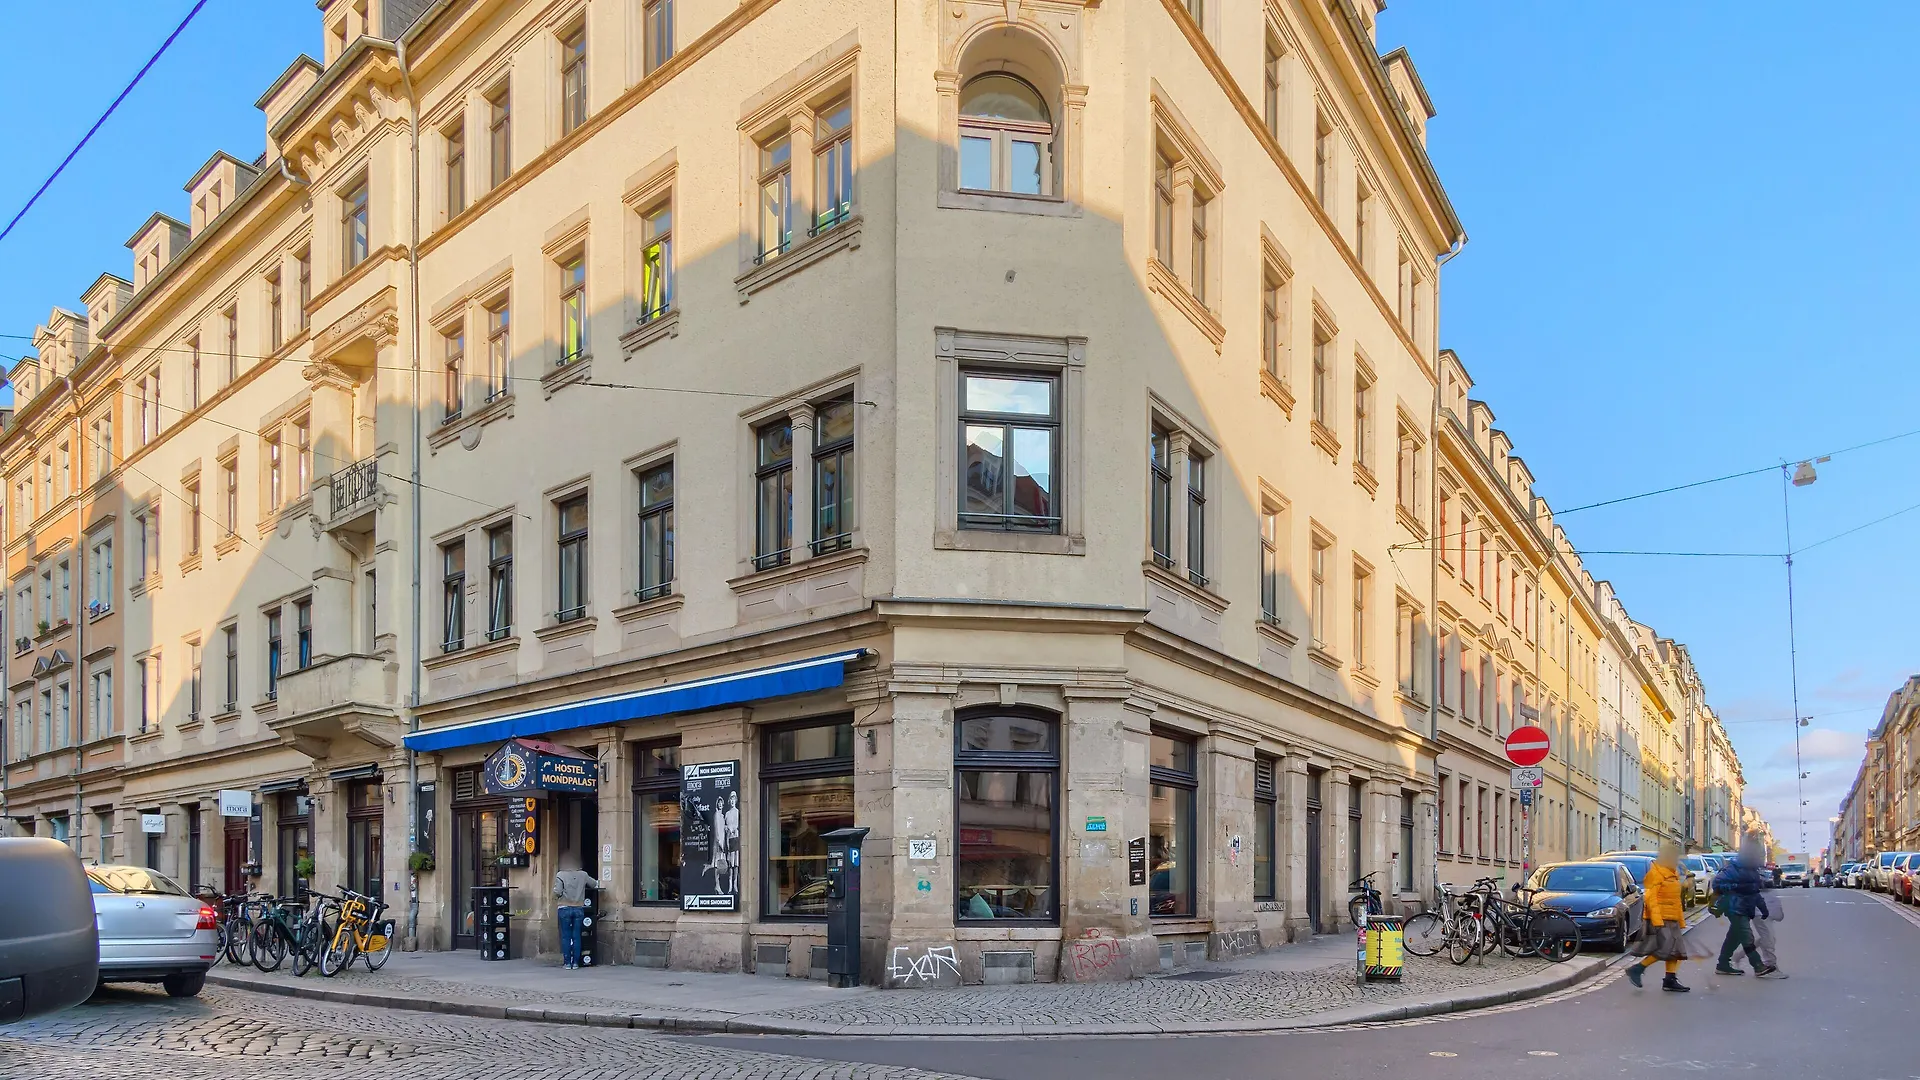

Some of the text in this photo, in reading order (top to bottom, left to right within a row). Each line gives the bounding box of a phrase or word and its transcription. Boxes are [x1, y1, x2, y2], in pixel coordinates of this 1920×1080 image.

[554, 763, 585, 775] HOSTEL
[542, 774, 596, 787] MONDPALAST
[852, 849, 859, 863] P
